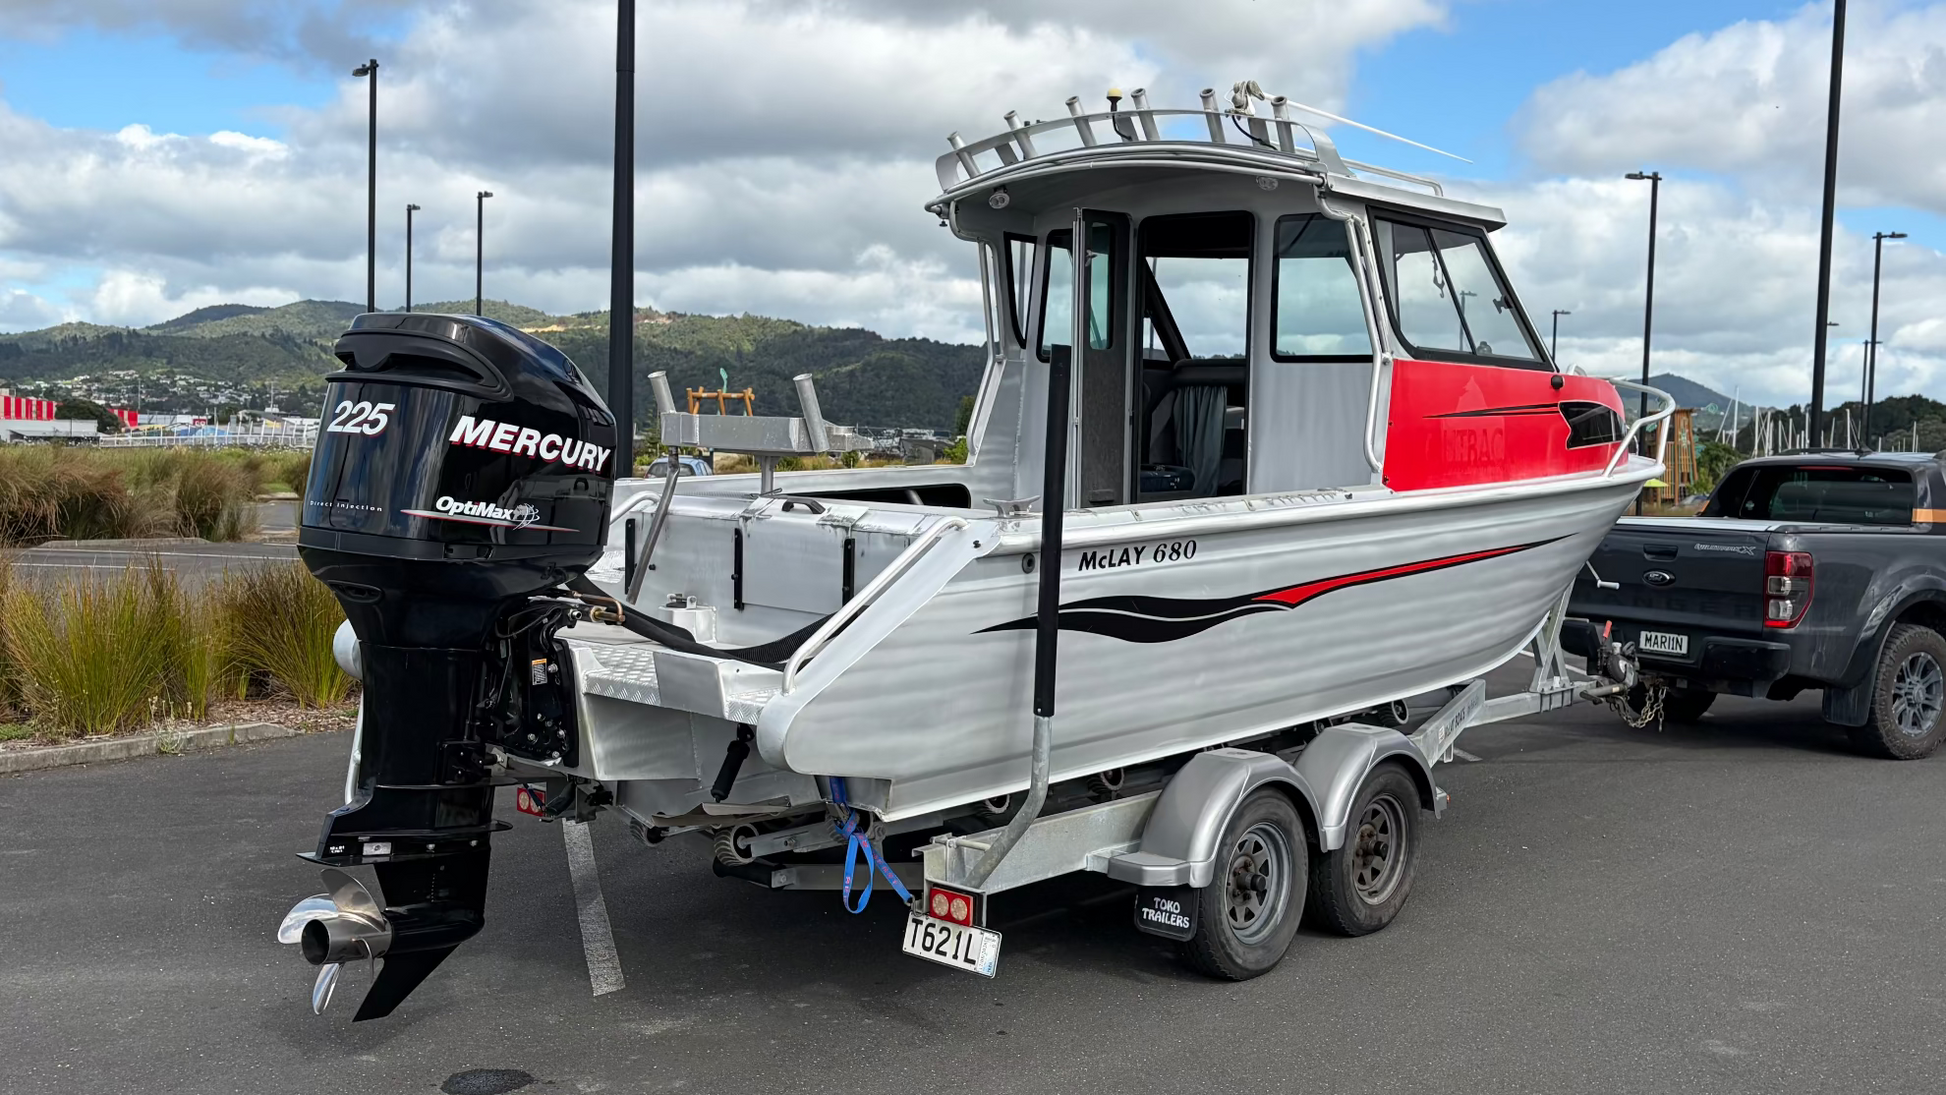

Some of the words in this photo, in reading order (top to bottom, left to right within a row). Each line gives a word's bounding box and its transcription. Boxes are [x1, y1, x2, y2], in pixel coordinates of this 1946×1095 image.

[326, 400, 395, 437] 225
[449, 415, 611, 473] MERCURY
[309, 500, 333, 508] Direct
[337, 502, 383, 512] Injection
[435, 495, 514, 521] OptiMax
[1078, 545, 1147, 571] McLAY
[1153, 540, 1197, 563] 680
[1142, 907, 1190, 929] TRAILERS
[1153, 897, 1181, 914] TOKO
[911, 918, 977, 966] T621L
